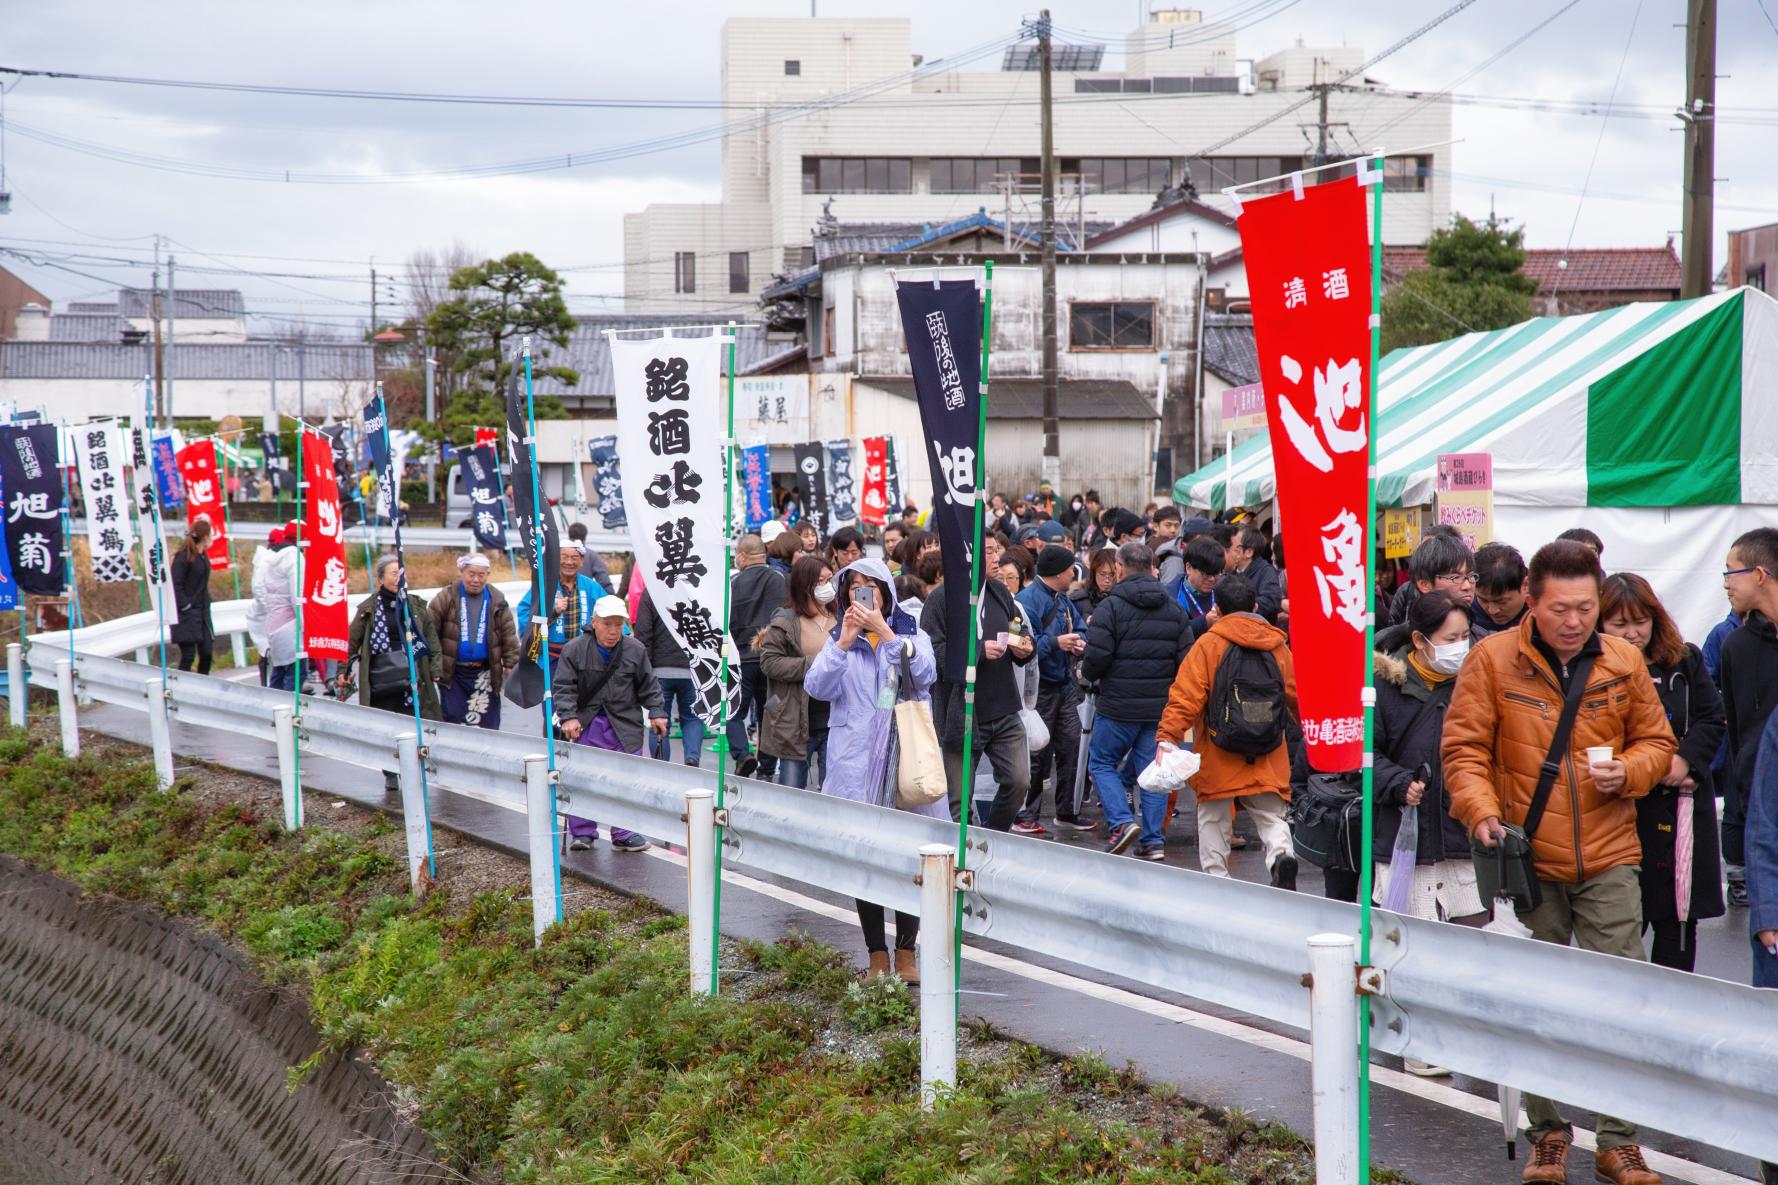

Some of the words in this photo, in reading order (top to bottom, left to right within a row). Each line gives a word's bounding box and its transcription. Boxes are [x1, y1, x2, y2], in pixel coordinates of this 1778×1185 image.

[1284, 268, 1350, 310] 清酒
[925, 310, 965, 411] 筑後の地酒
[8, 491, 58, 575] 旭菊
[86, 430, 124, 553] 銘酒比翼鶴
[471, 486, 499, 537] 旭菊
[643, 356, 725, 652] 銘酒比翼鶴
[1278, 355, 1368, 633] 池亀
